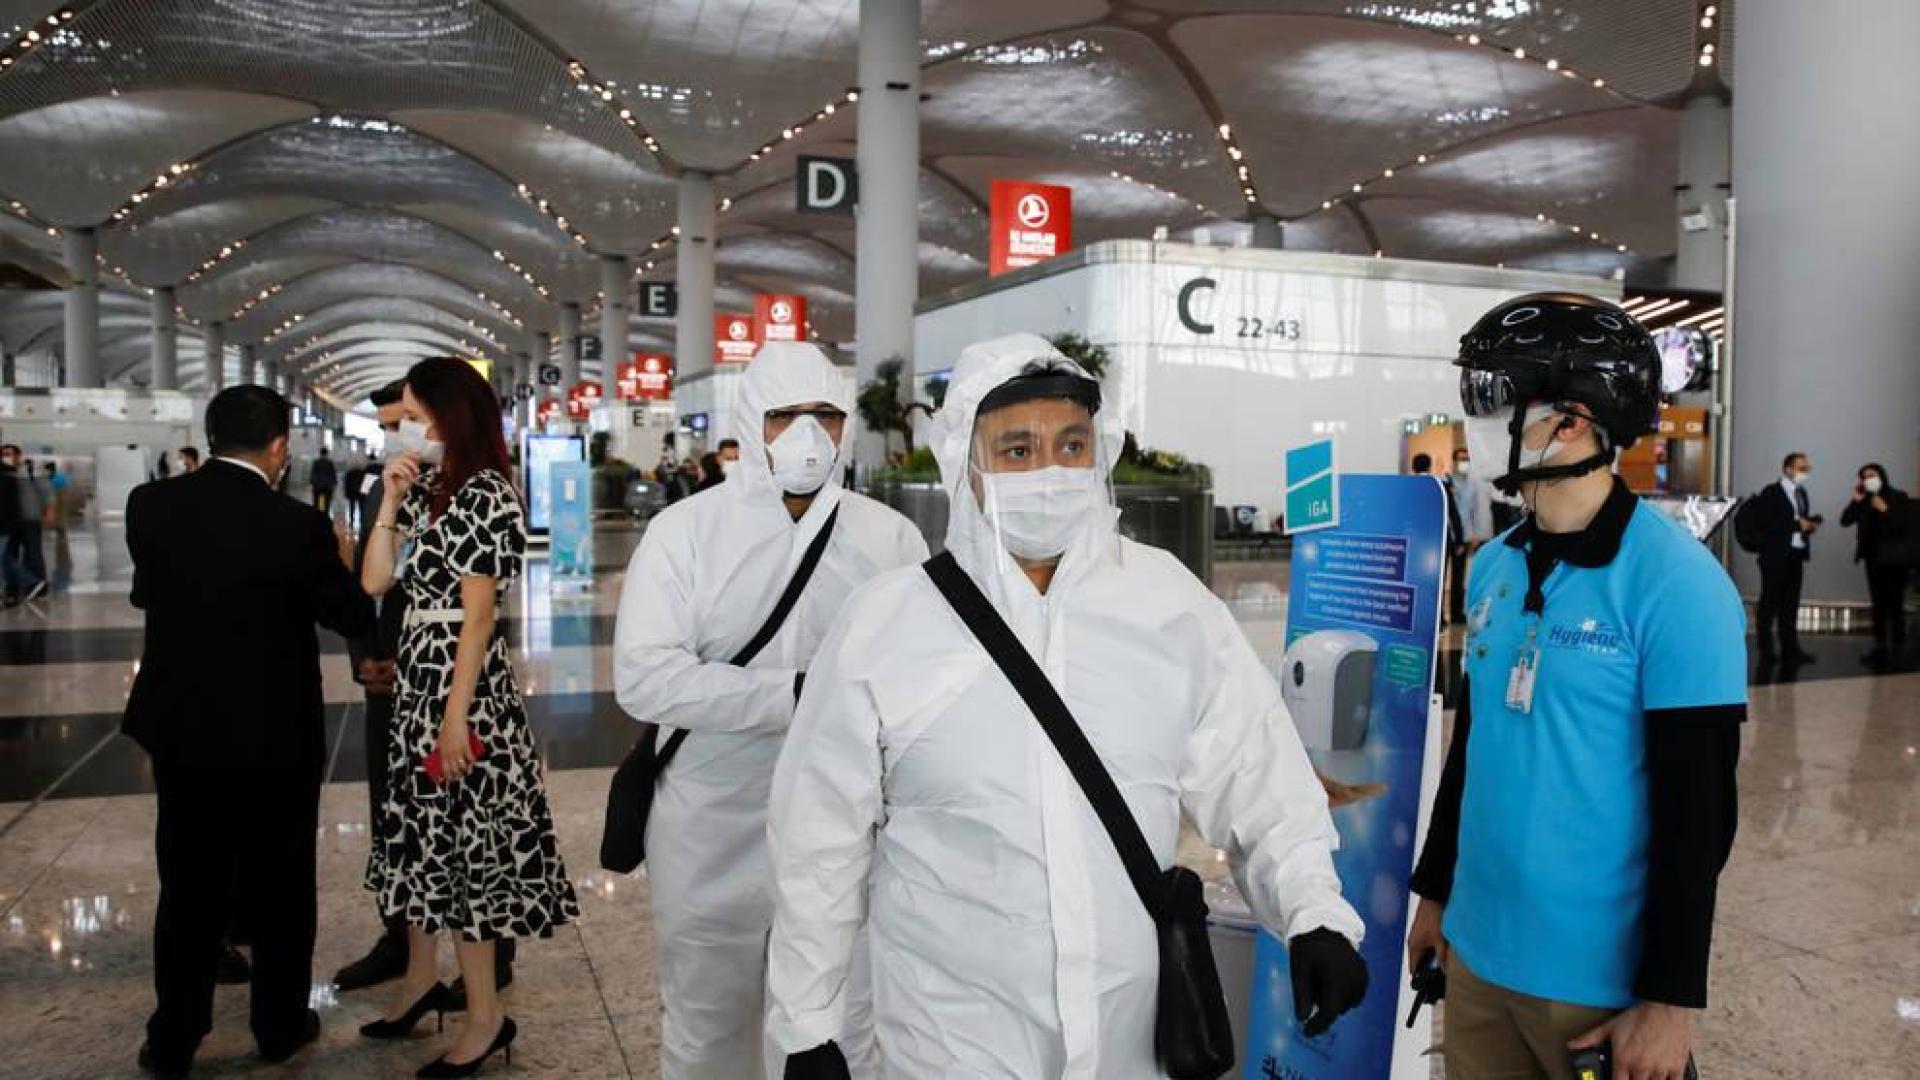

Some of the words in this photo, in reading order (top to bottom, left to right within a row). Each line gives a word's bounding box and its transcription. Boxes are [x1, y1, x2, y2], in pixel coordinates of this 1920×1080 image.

[807, 161, 846, 208] D
[649, 286, 667, 313] E
[1177, 277, 1216, 334] C
[1236, 317, 1300, 341] 22-43
[581, 338, 594, 359] F
[633, 409, 644, 427] E
[1549, 624, 1617, 649] Hygiene
